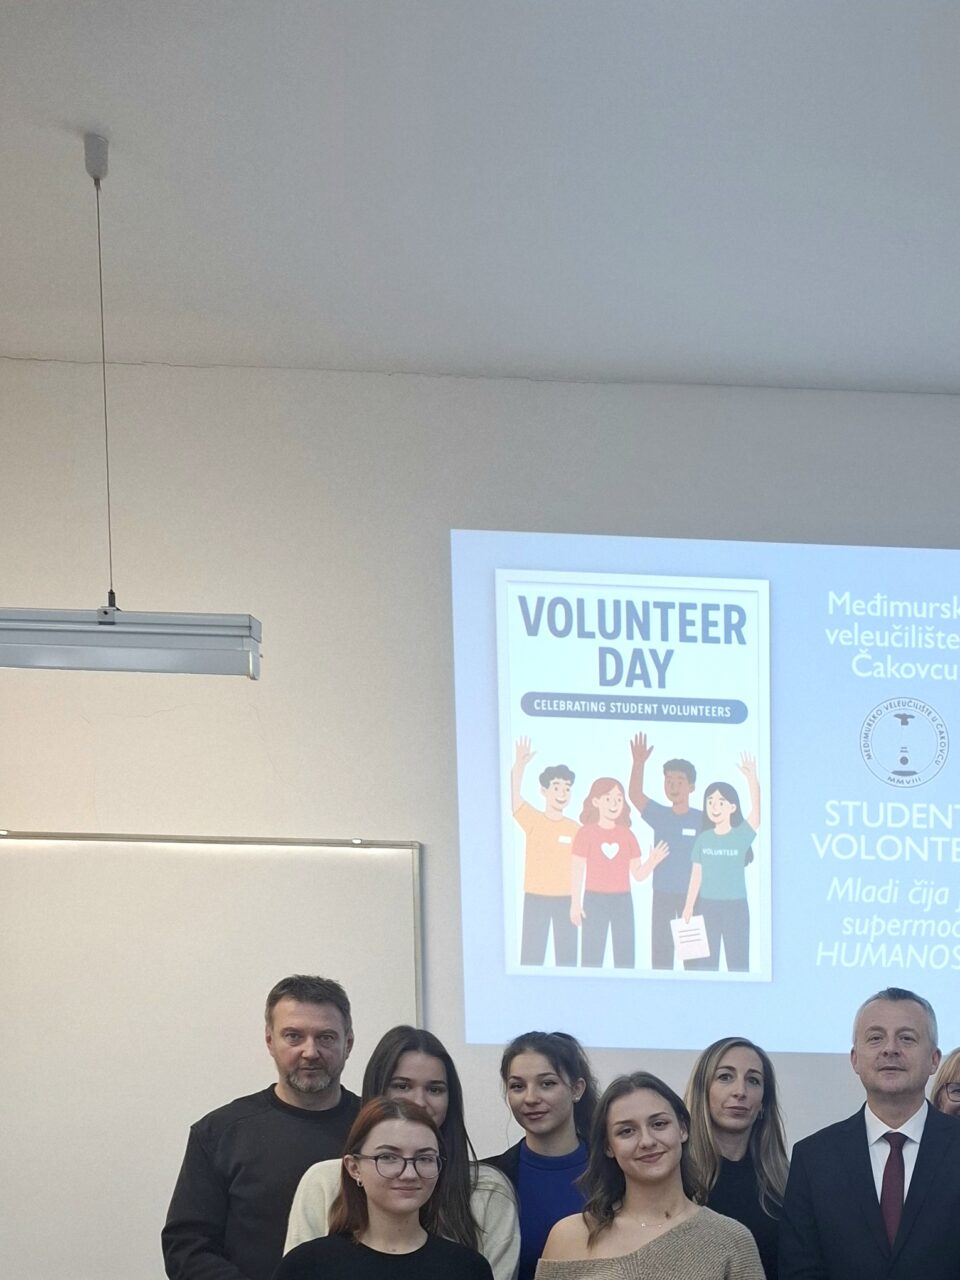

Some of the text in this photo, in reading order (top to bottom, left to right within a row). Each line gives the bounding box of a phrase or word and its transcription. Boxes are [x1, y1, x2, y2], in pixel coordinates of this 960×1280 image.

[518, 595, 747, 645] VOLUNTEER
[825, 621, 960, 650] veleučilište
[598, 646, 675, 689] DAY
[851, 648, 958, 681] Čakovcu
[533, 699, 732, 718] CELEBRATING STUDENT VOLUNTEERS
[702, 847, 739, 857] VOLUNTEER
[826, 876, 900, 904] Mladi
[908, 879, 950, 912] čija
